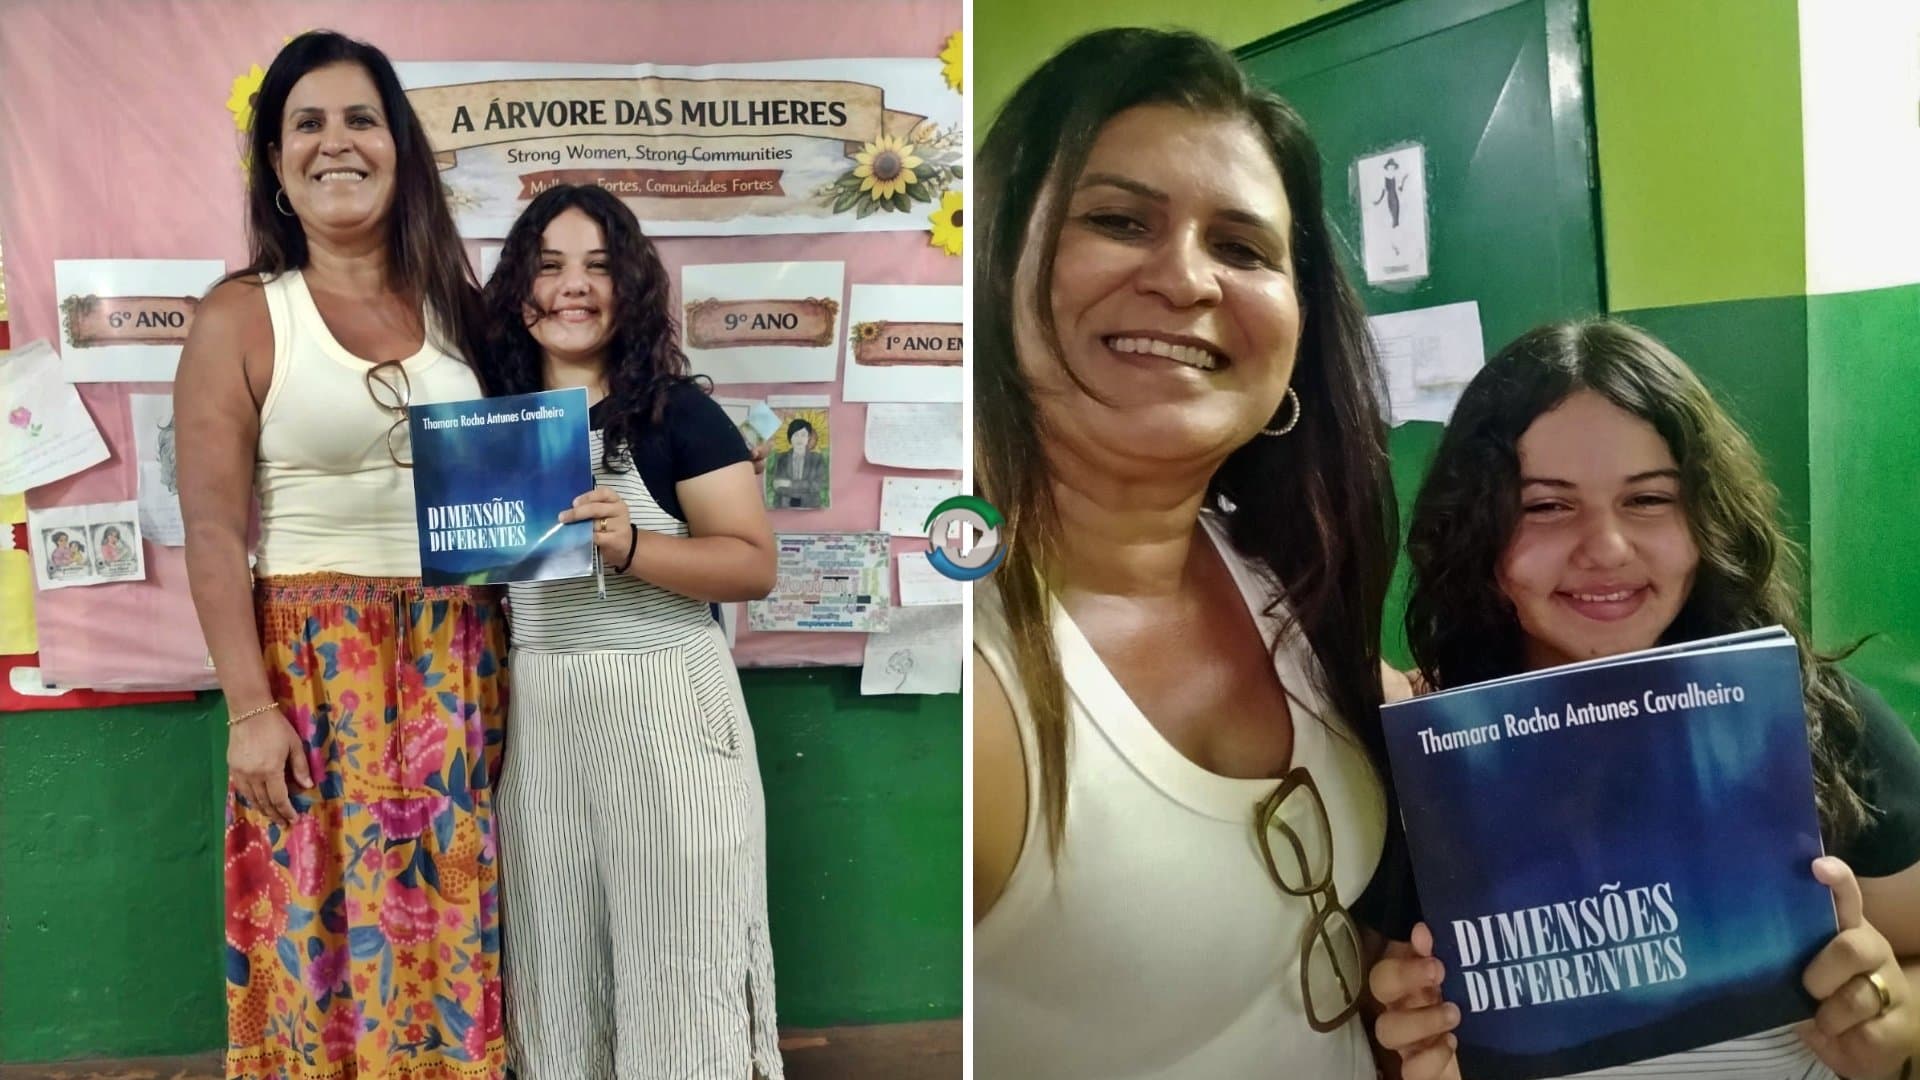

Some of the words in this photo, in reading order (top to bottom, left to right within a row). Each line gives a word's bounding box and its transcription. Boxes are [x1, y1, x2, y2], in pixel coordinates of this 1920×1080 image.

[451, 106, 474, 133] A
[484, 98, 606, 130] ÁRVORE
[615, 98, 673, 126] DAS
[681, 100, 847, 127] MULHERES
[507, 147, 561, 164] Strong
[566, 144, 631, 162] Women,
[635, 145, 687, 164] Strong
[691, 145, 793, 162] Communities
[646, 176, 727, 194] Comunidades
[733, 177, 773, 192] Fortes
[136, 311, 185, 328] ANO
[751, 313, 798, 331] ANO
[903, 337, 942, 351] ANO
[423, 417, 459, 431] Thamara
[461, 412, 485, 427] Rocha
[487, 412, 519, 425] Antunes
[521, 406, 565, 421] Cavalheiro
[427, 497, 526, 530] DIMENSÕES
[430, 525, 526, 552] DIFERENTES
[1417, 722, 1501, 755] Thamara
[1504, 707, 1560, 739] Rocha
[1565, 698, 1639, 728] Antunes
[1644, 682, 1745, 715] Cavalheiro
[1451, 881, 1680, 968] DIMENSÕES
[1463, 936, 1687, 1013] DIFERENTES
